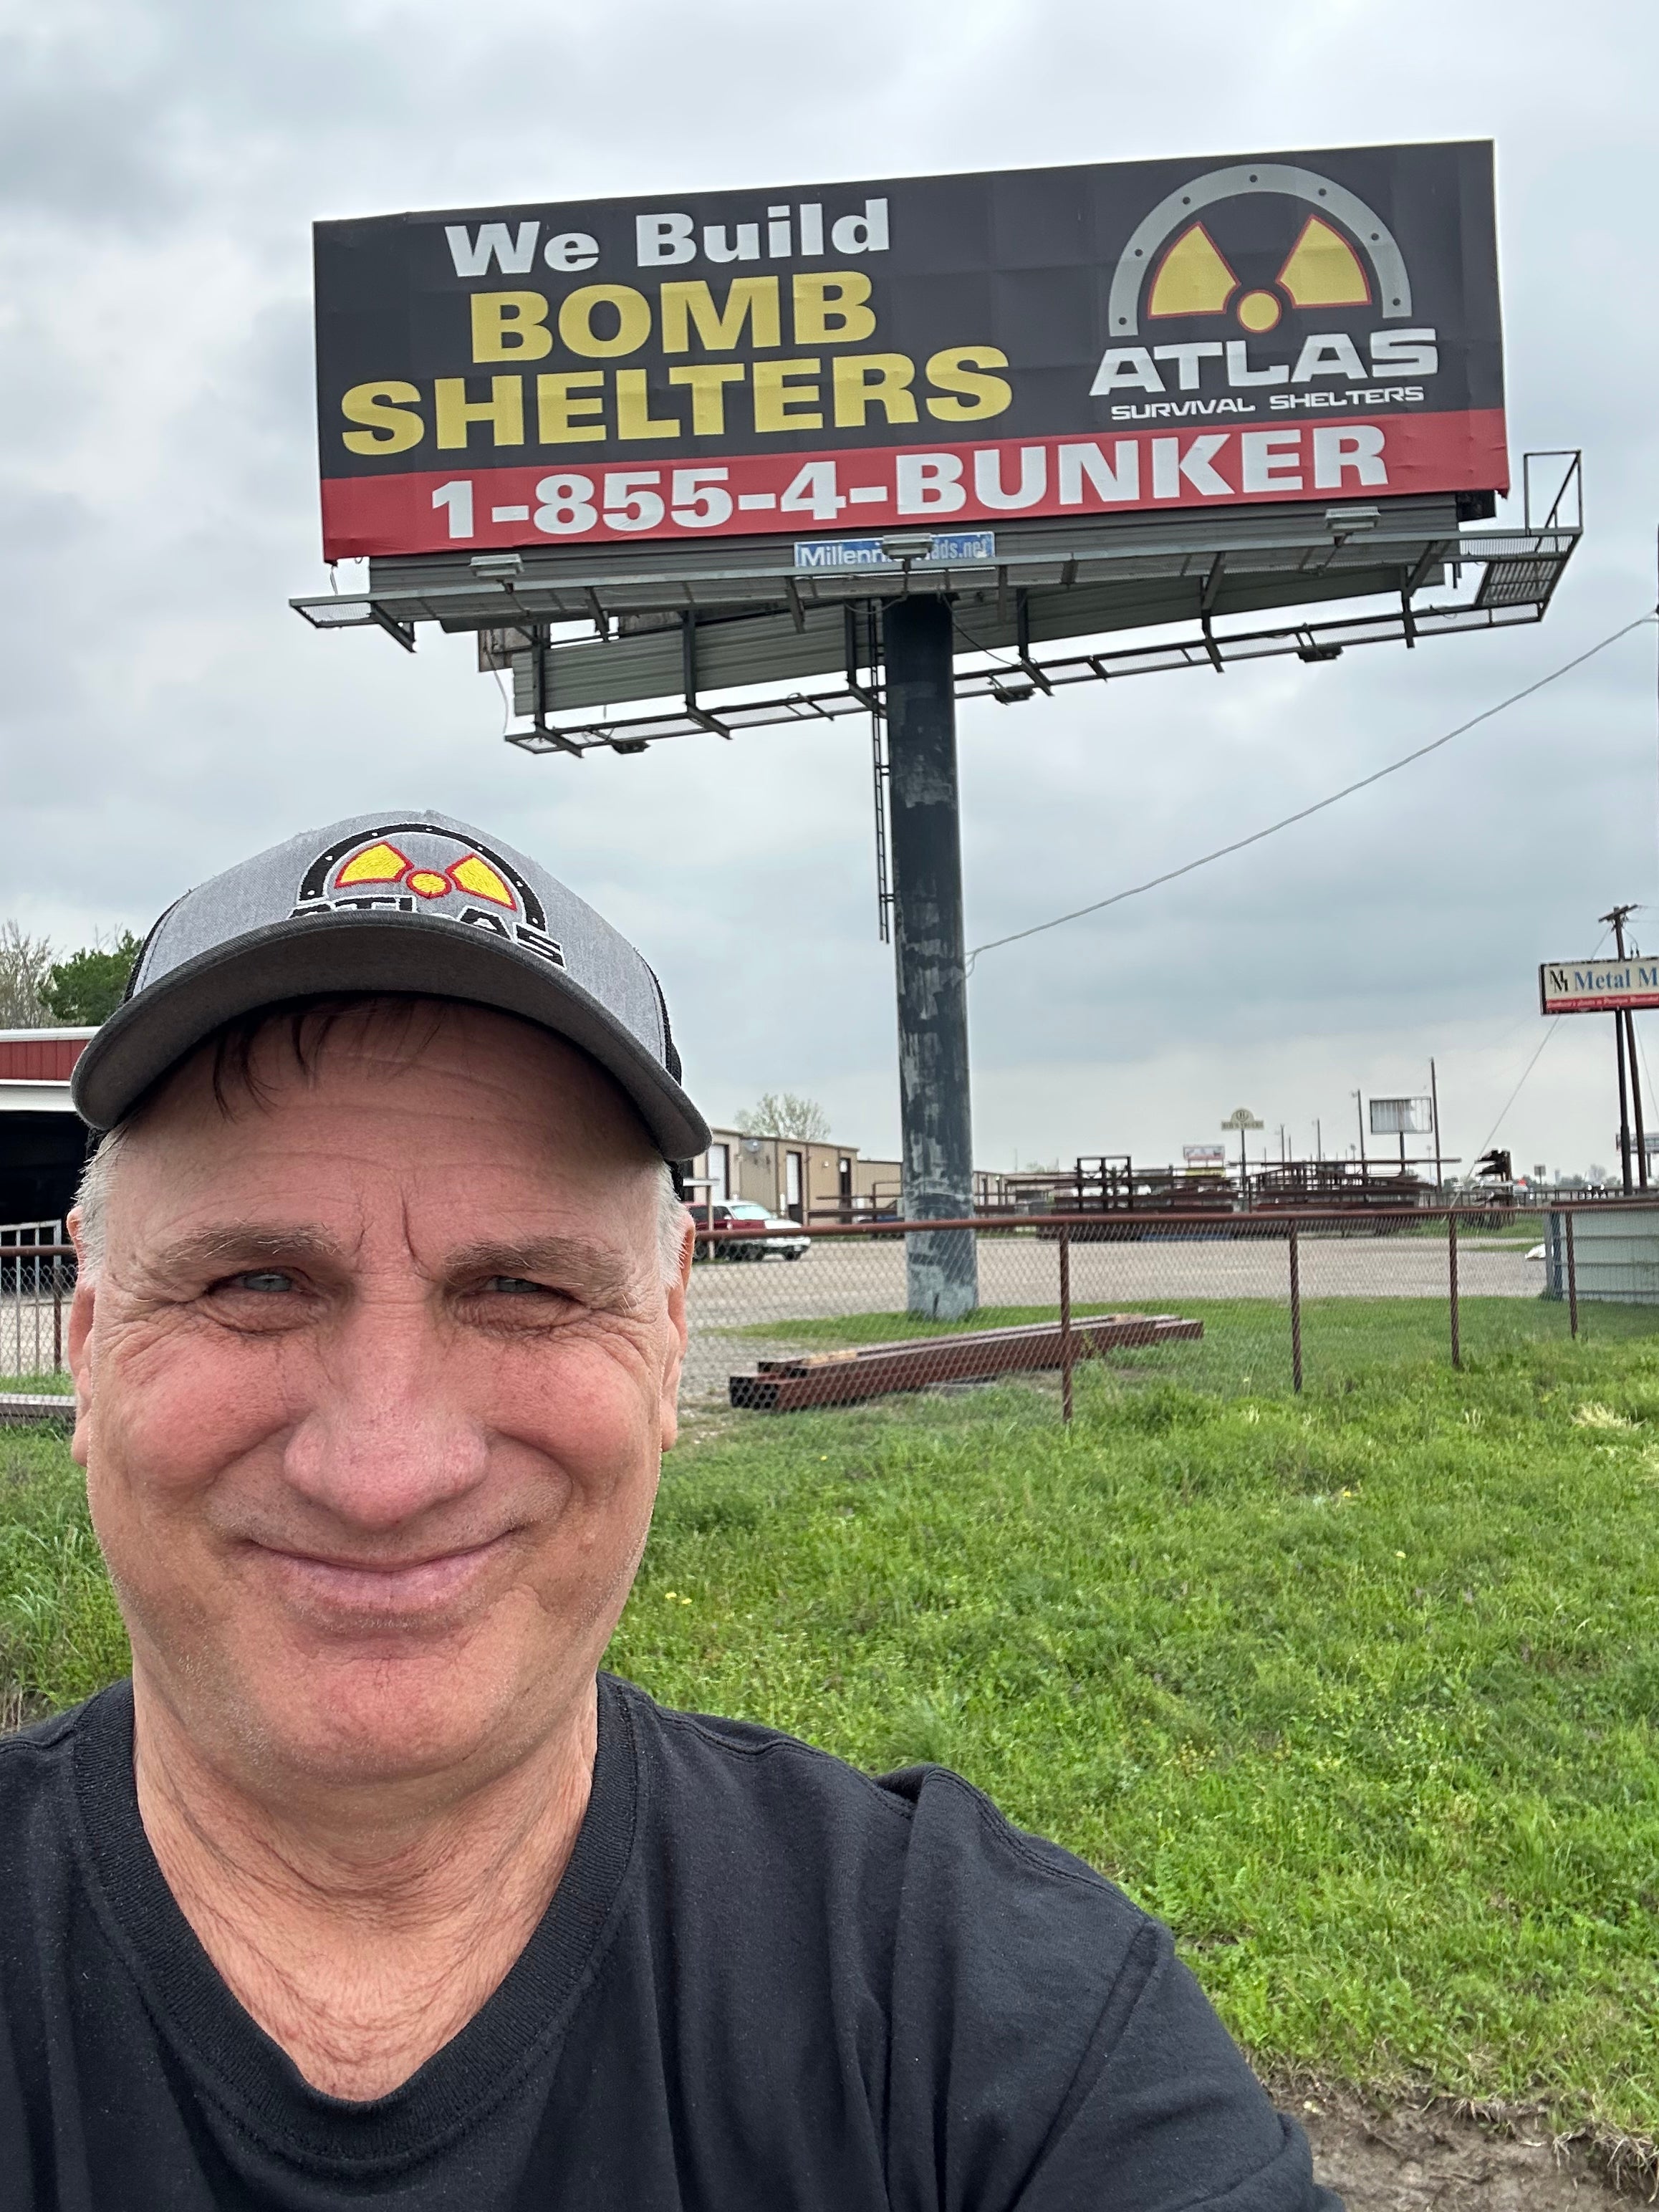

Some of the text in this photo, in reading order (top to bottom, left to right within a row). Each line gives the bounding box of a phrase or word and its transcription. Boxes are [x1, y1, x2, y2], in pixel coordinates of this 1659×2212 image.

[445, 198, 890, 277] We Build
[471, 271, 877, 363] BOMB
[1088, 327, 1439, 396] ATLAS
[340, 347, 1013, 456] SHELTERS
[1110, 386, 1425, 421] SURVIVAL SHELTERS
[431, 425, 1389, 539] 1-855-4-BUNKER
[1574, 968, 1632, 991] Metal
